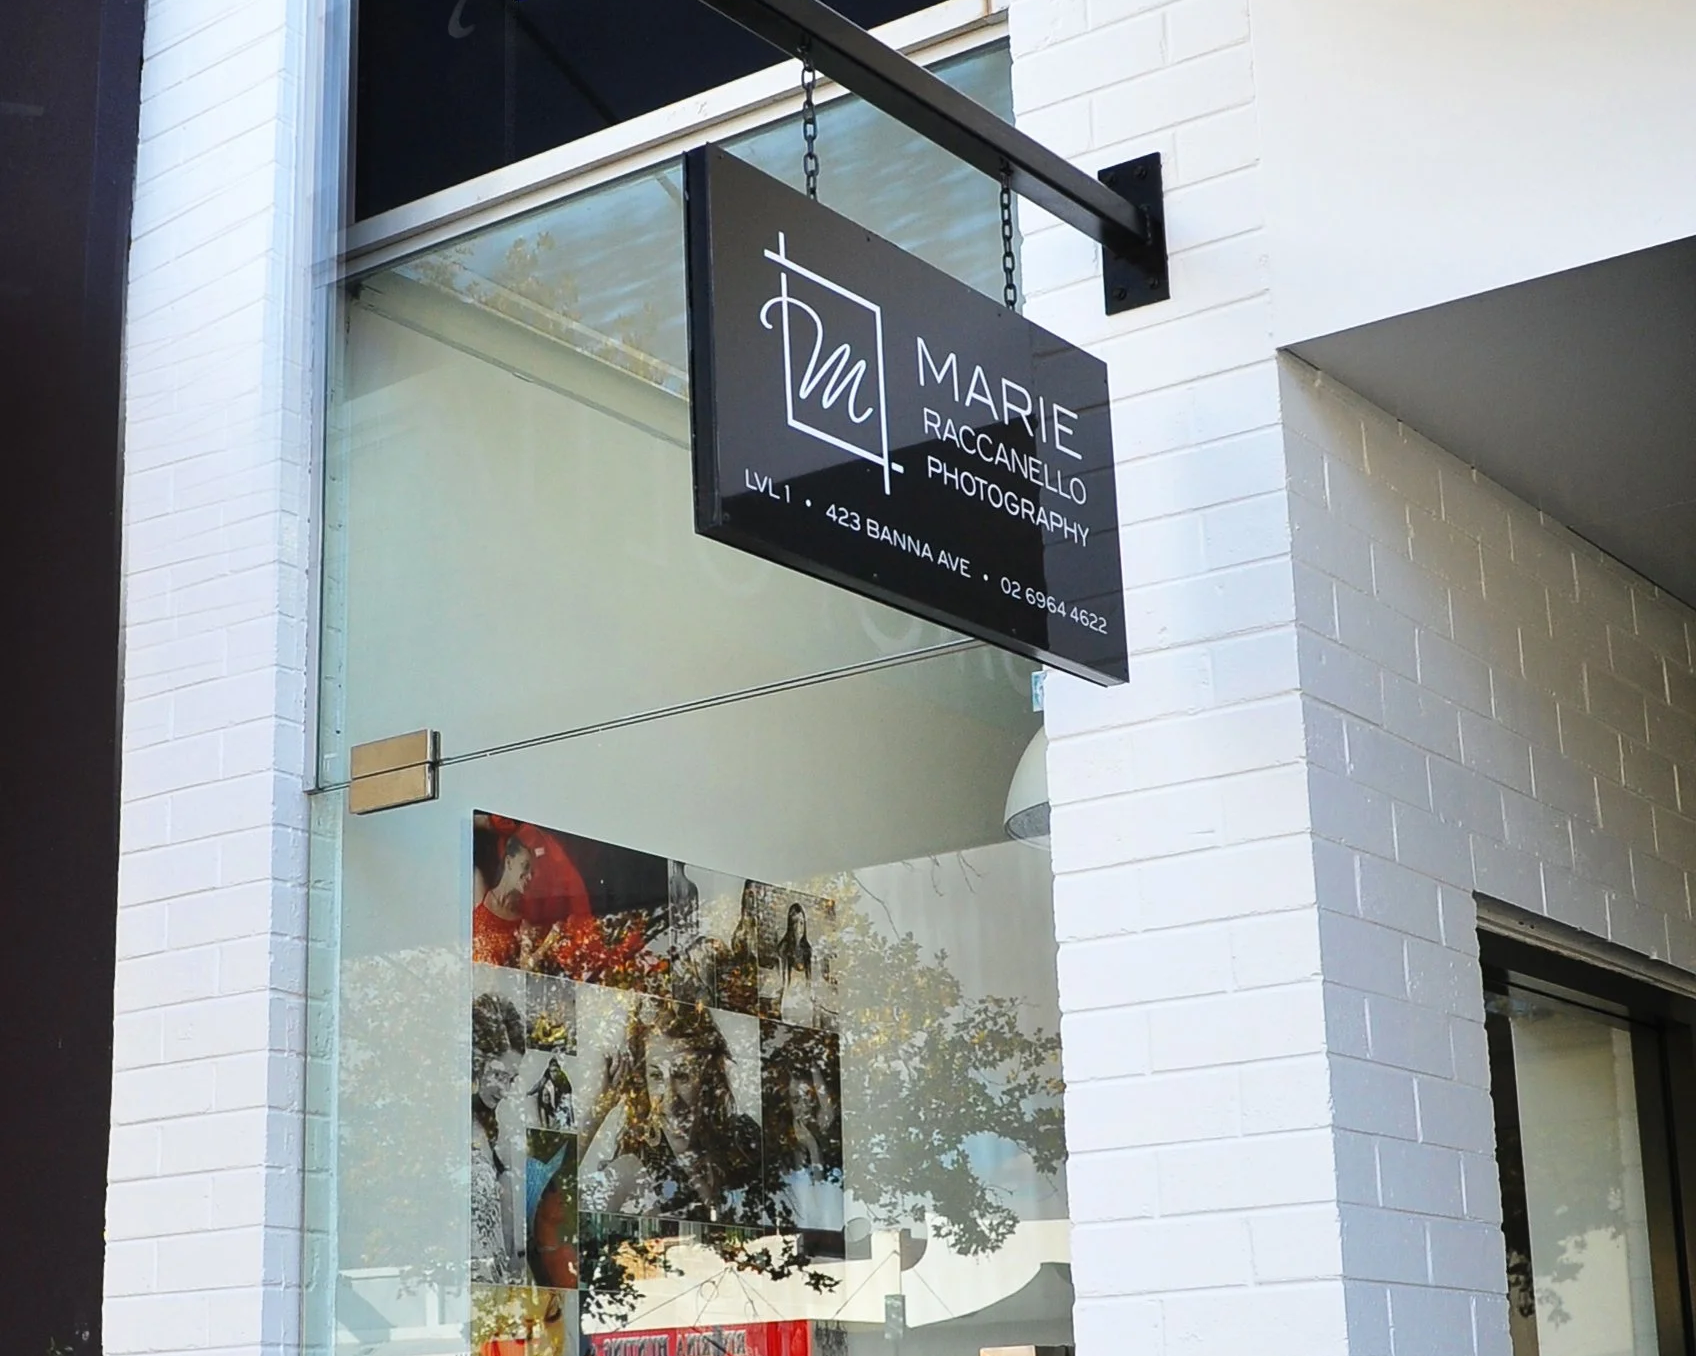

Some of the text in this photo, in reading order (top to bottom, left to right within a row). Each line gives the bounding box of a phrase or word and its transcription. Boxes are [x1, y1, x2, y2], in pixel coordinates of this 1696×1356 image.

[916, 336, 1082, 460] MARIE
[923, 407, 1087, 505] RACCANELLO
[927, 455, 1090, 547] PHOTOGRAPHY
[745, 468, 780, 499] LVL
[826, 504, 861, 531] 423
[866, 518, 934, 563] BANNA
[938, 549, 972, 578] AVE
[1000, 576, 1022, 600] 02
[1025, 587, 1067, 617] 6964
[1070, 606, 1108, 635] 4622
